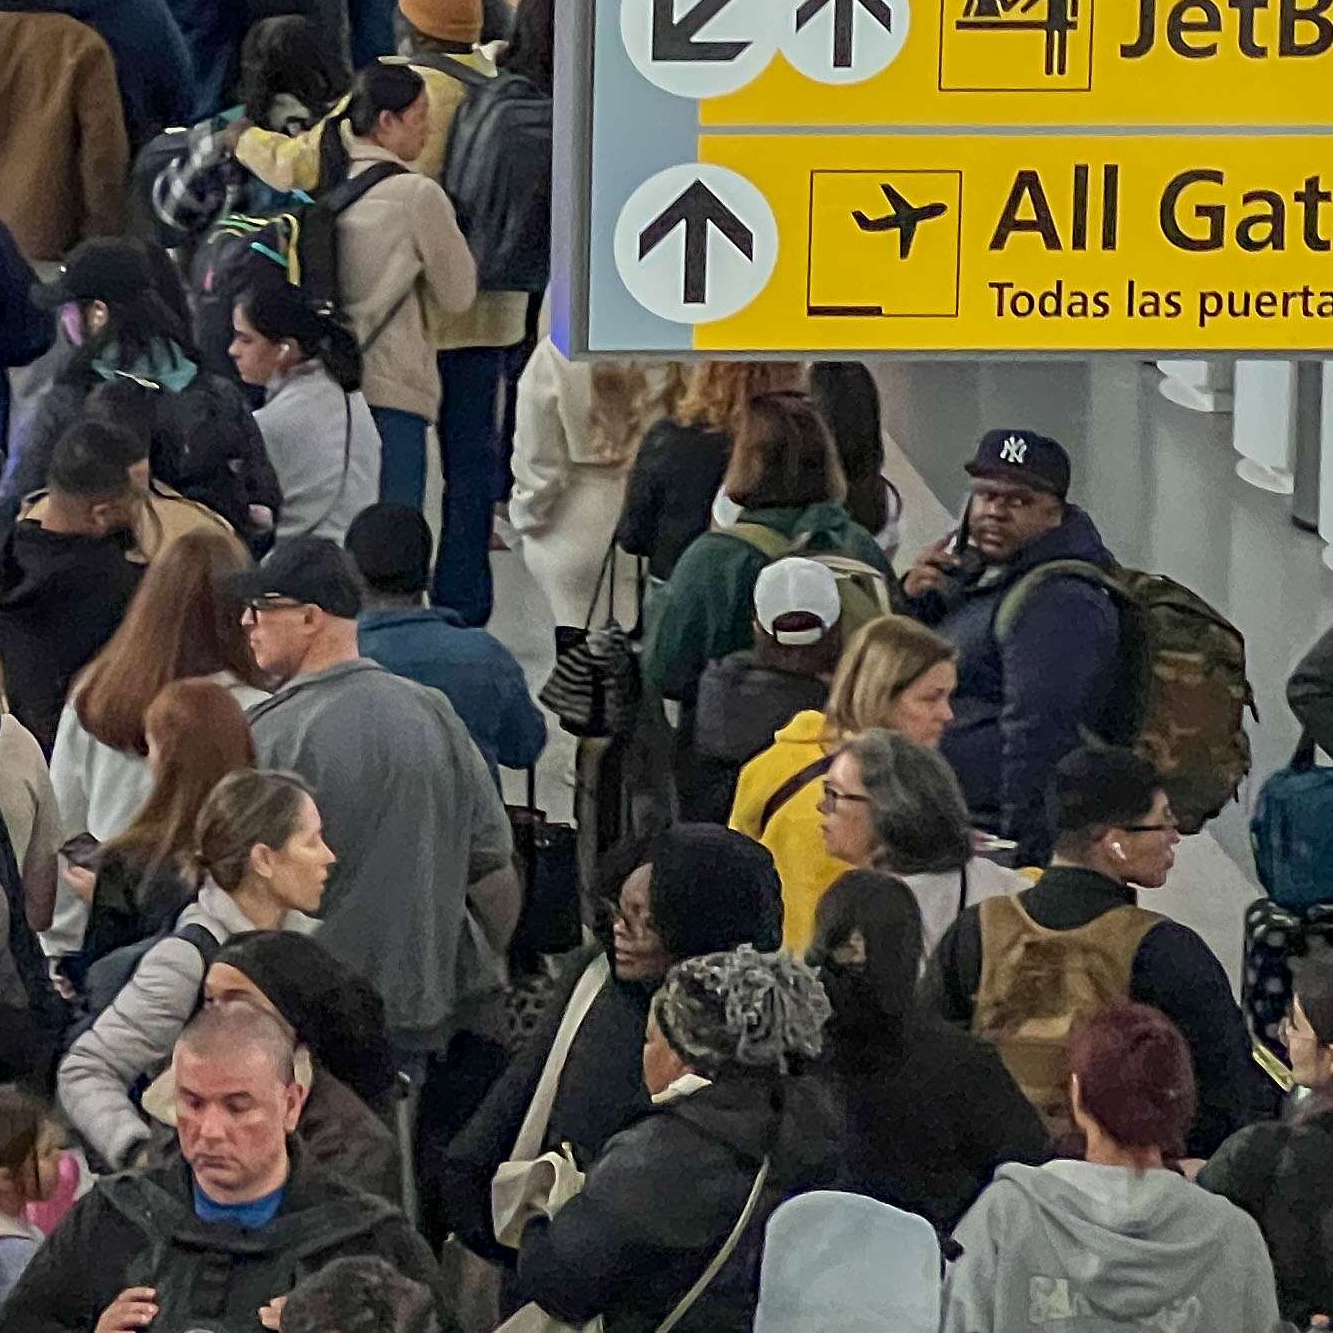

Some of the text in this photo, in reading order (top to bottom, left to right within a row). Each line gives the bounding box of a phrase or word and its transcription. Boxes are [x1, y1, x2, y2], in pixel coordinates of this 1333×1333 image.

[988, 163, 1333, 253] All Gat
[987, 279, 1111, 319] Todas
[1126, 279, 1183, 319] las
